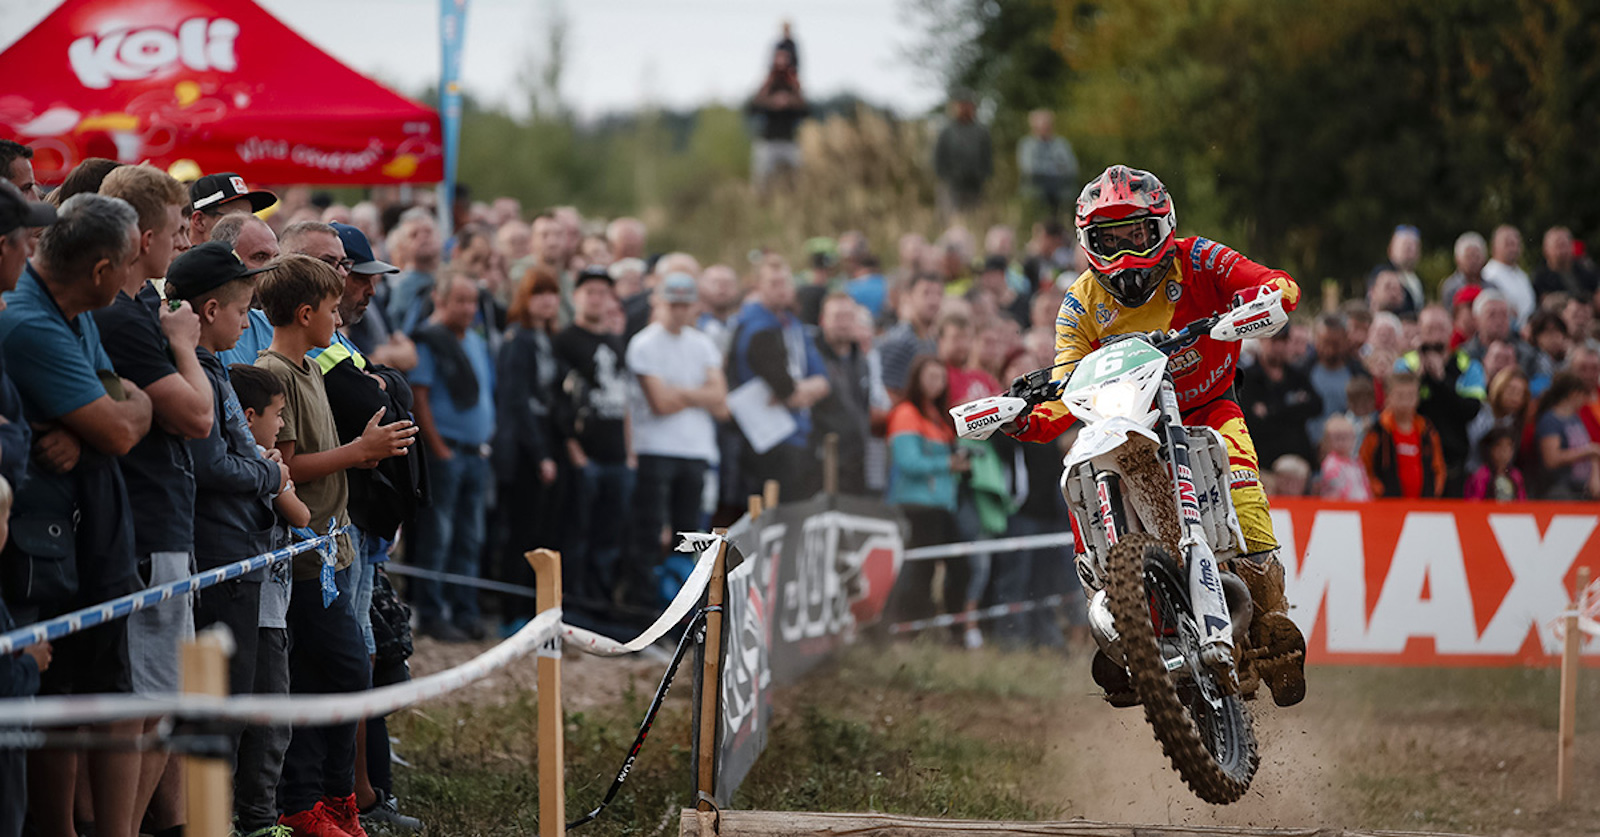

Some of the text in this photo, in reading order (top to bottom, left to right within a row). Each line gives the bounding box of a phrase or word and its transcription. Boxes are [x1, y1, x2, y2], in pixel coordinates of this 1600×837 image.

[1234, 318, 1273, 336] SOUDAL
[1094, 350, 1125, 379] 6
[966, 413, 1002, 431] SOUDAL
[1270, 507, 1599, 655] MAX
